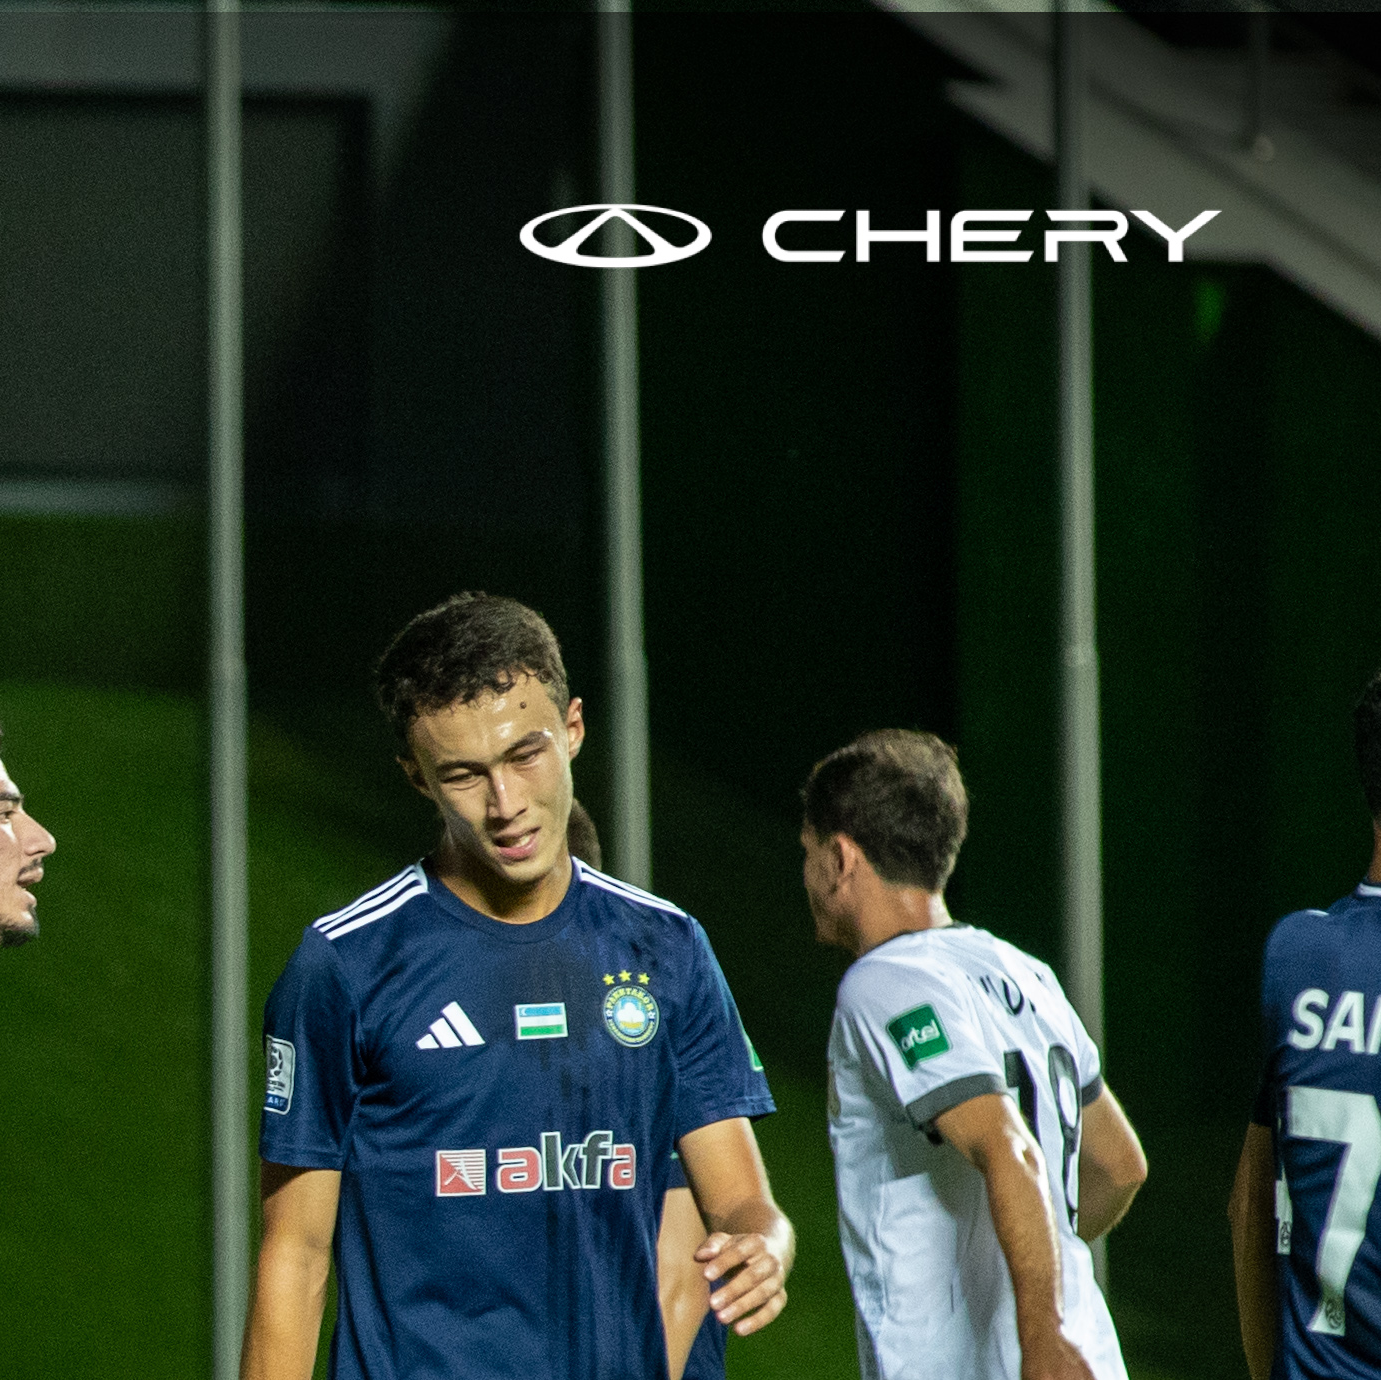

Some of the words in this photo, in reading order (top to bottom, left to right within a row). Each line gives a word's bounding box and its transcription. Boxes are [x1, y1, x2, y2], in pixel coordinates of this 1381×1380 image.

[900, 1019, 941, 1051] artel
[495, 1130, 636, 1193] akfa
[1275, 1085, 1381, 1337] 7
